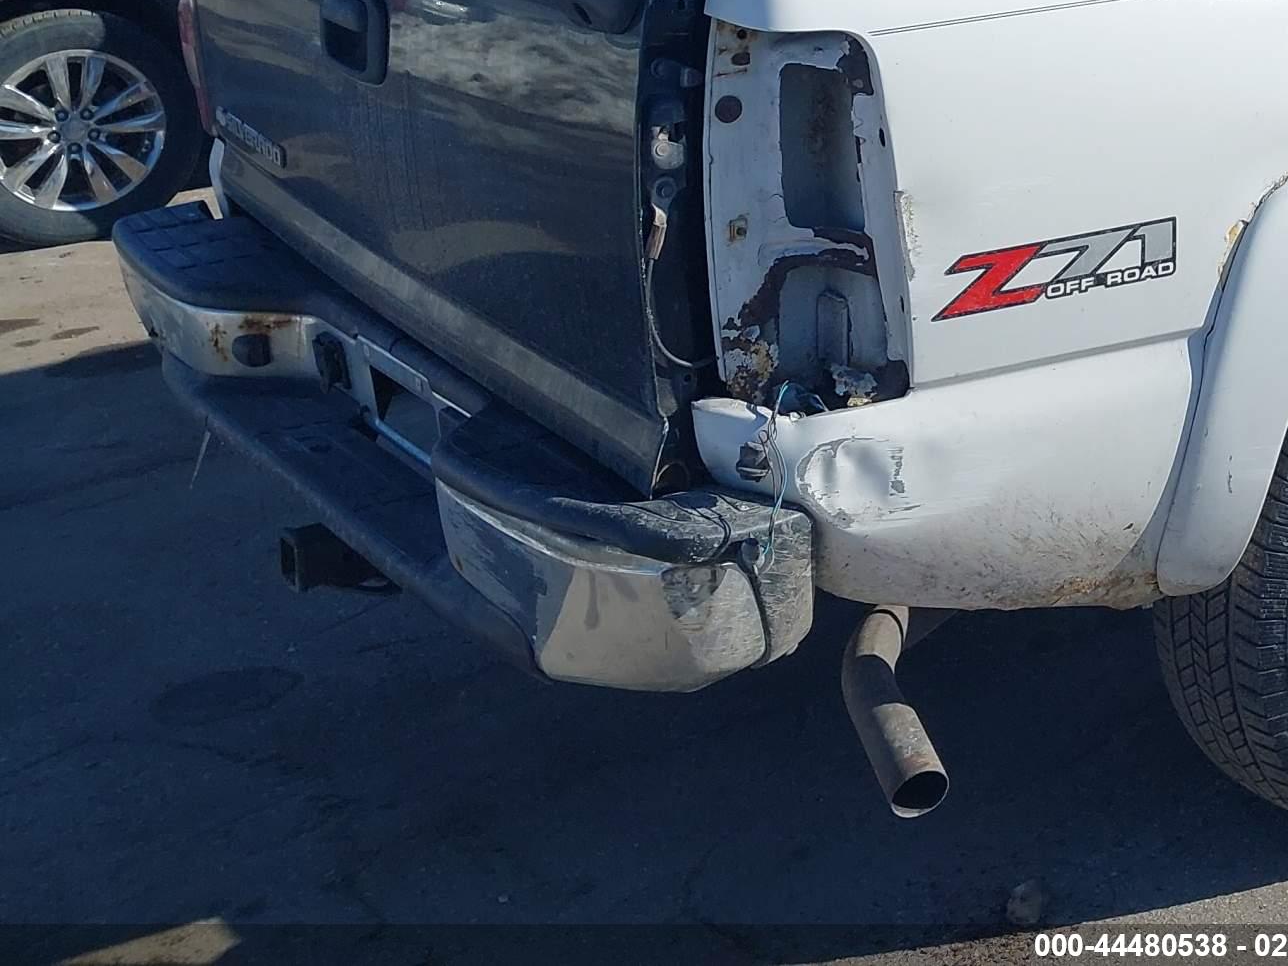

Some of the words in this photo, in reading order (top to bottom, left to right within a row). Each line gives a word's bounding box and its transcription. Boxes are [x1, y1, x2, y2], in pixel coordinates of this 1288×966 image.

[931, 217, 1177, 322] Z71
[1045, 275, 1095, 299] OFF
[1106, 261, 1175, 288] ROAD
